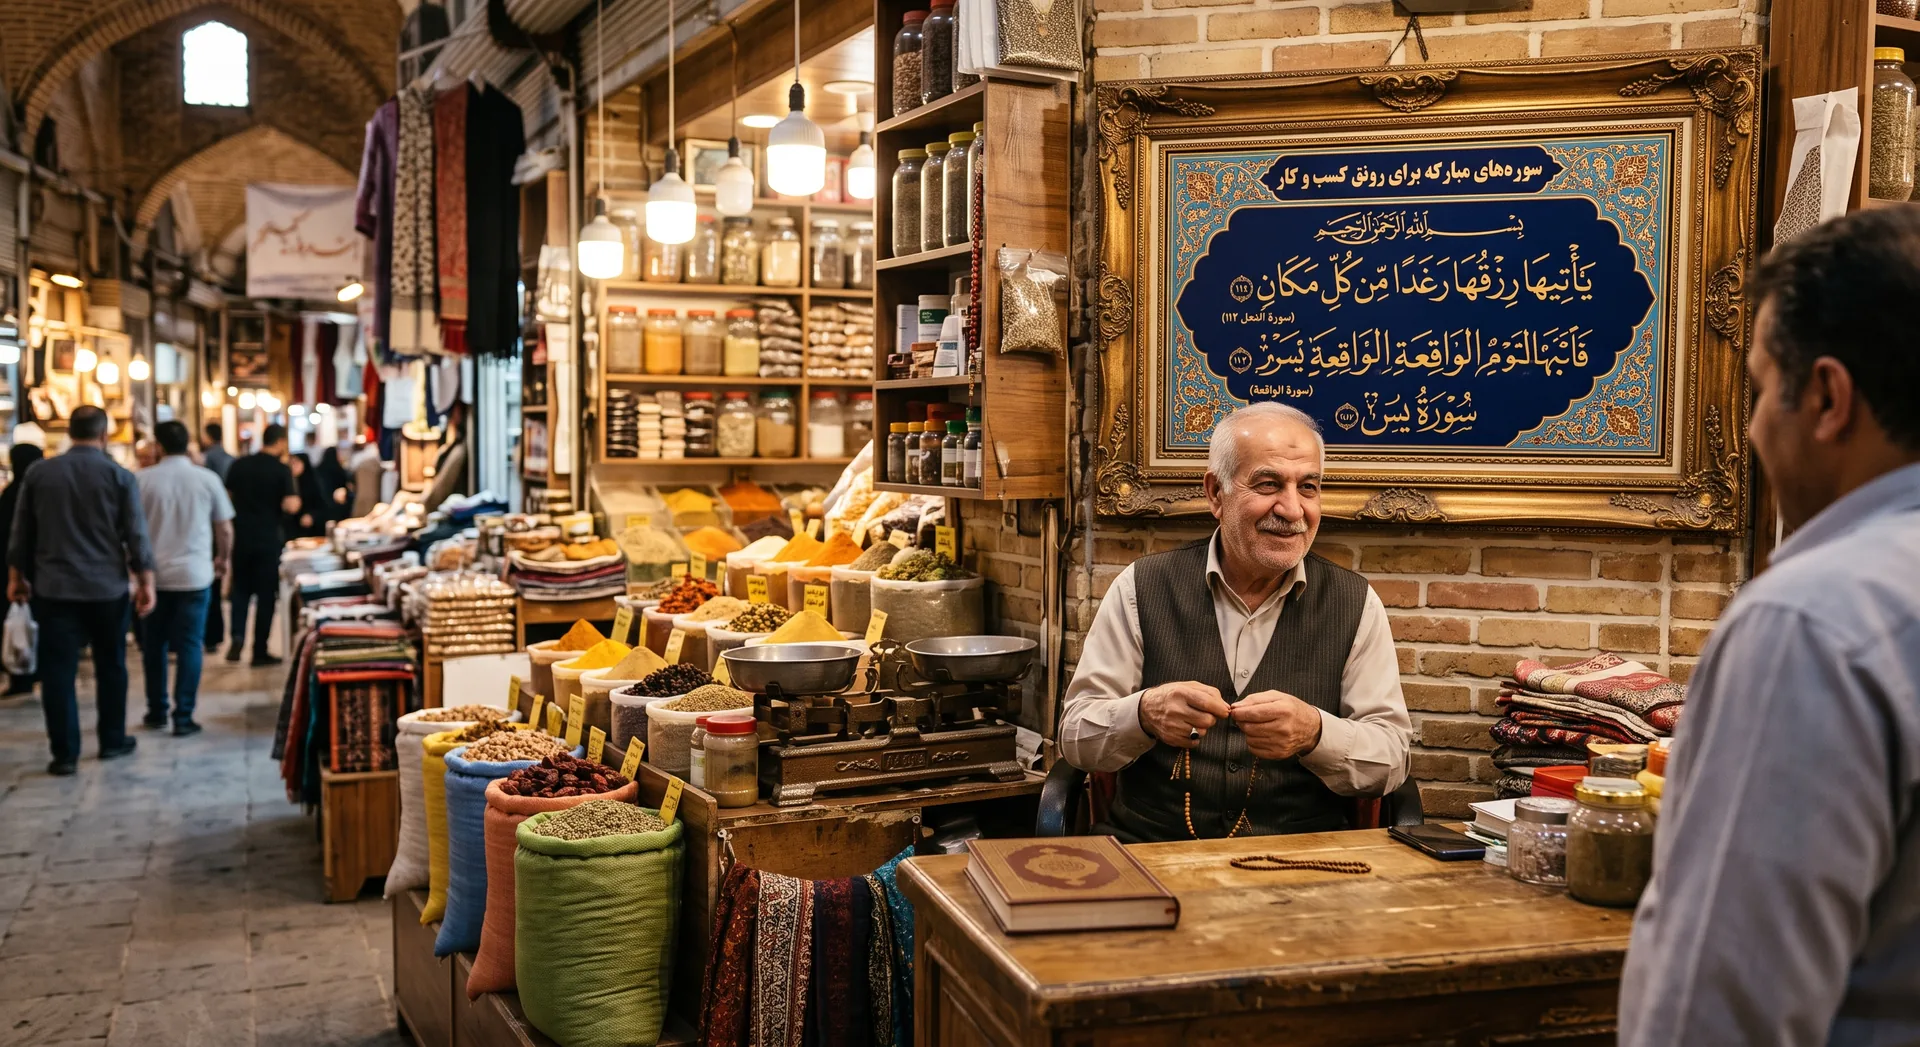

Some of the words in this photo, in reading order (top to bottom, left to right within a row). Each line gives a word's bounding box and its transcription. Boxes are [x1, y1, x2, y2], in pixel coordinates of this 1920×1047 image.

[1276, 167, 1299, 190] کار
[1301, 173, 1310, 190] و
[1312, 166, 1348, 188] کسب
[1351, 170, 1385, 188] رونق
[1388, 164, 1422, 186] برای
[1424, 162, 1470, 184] مبارکه
